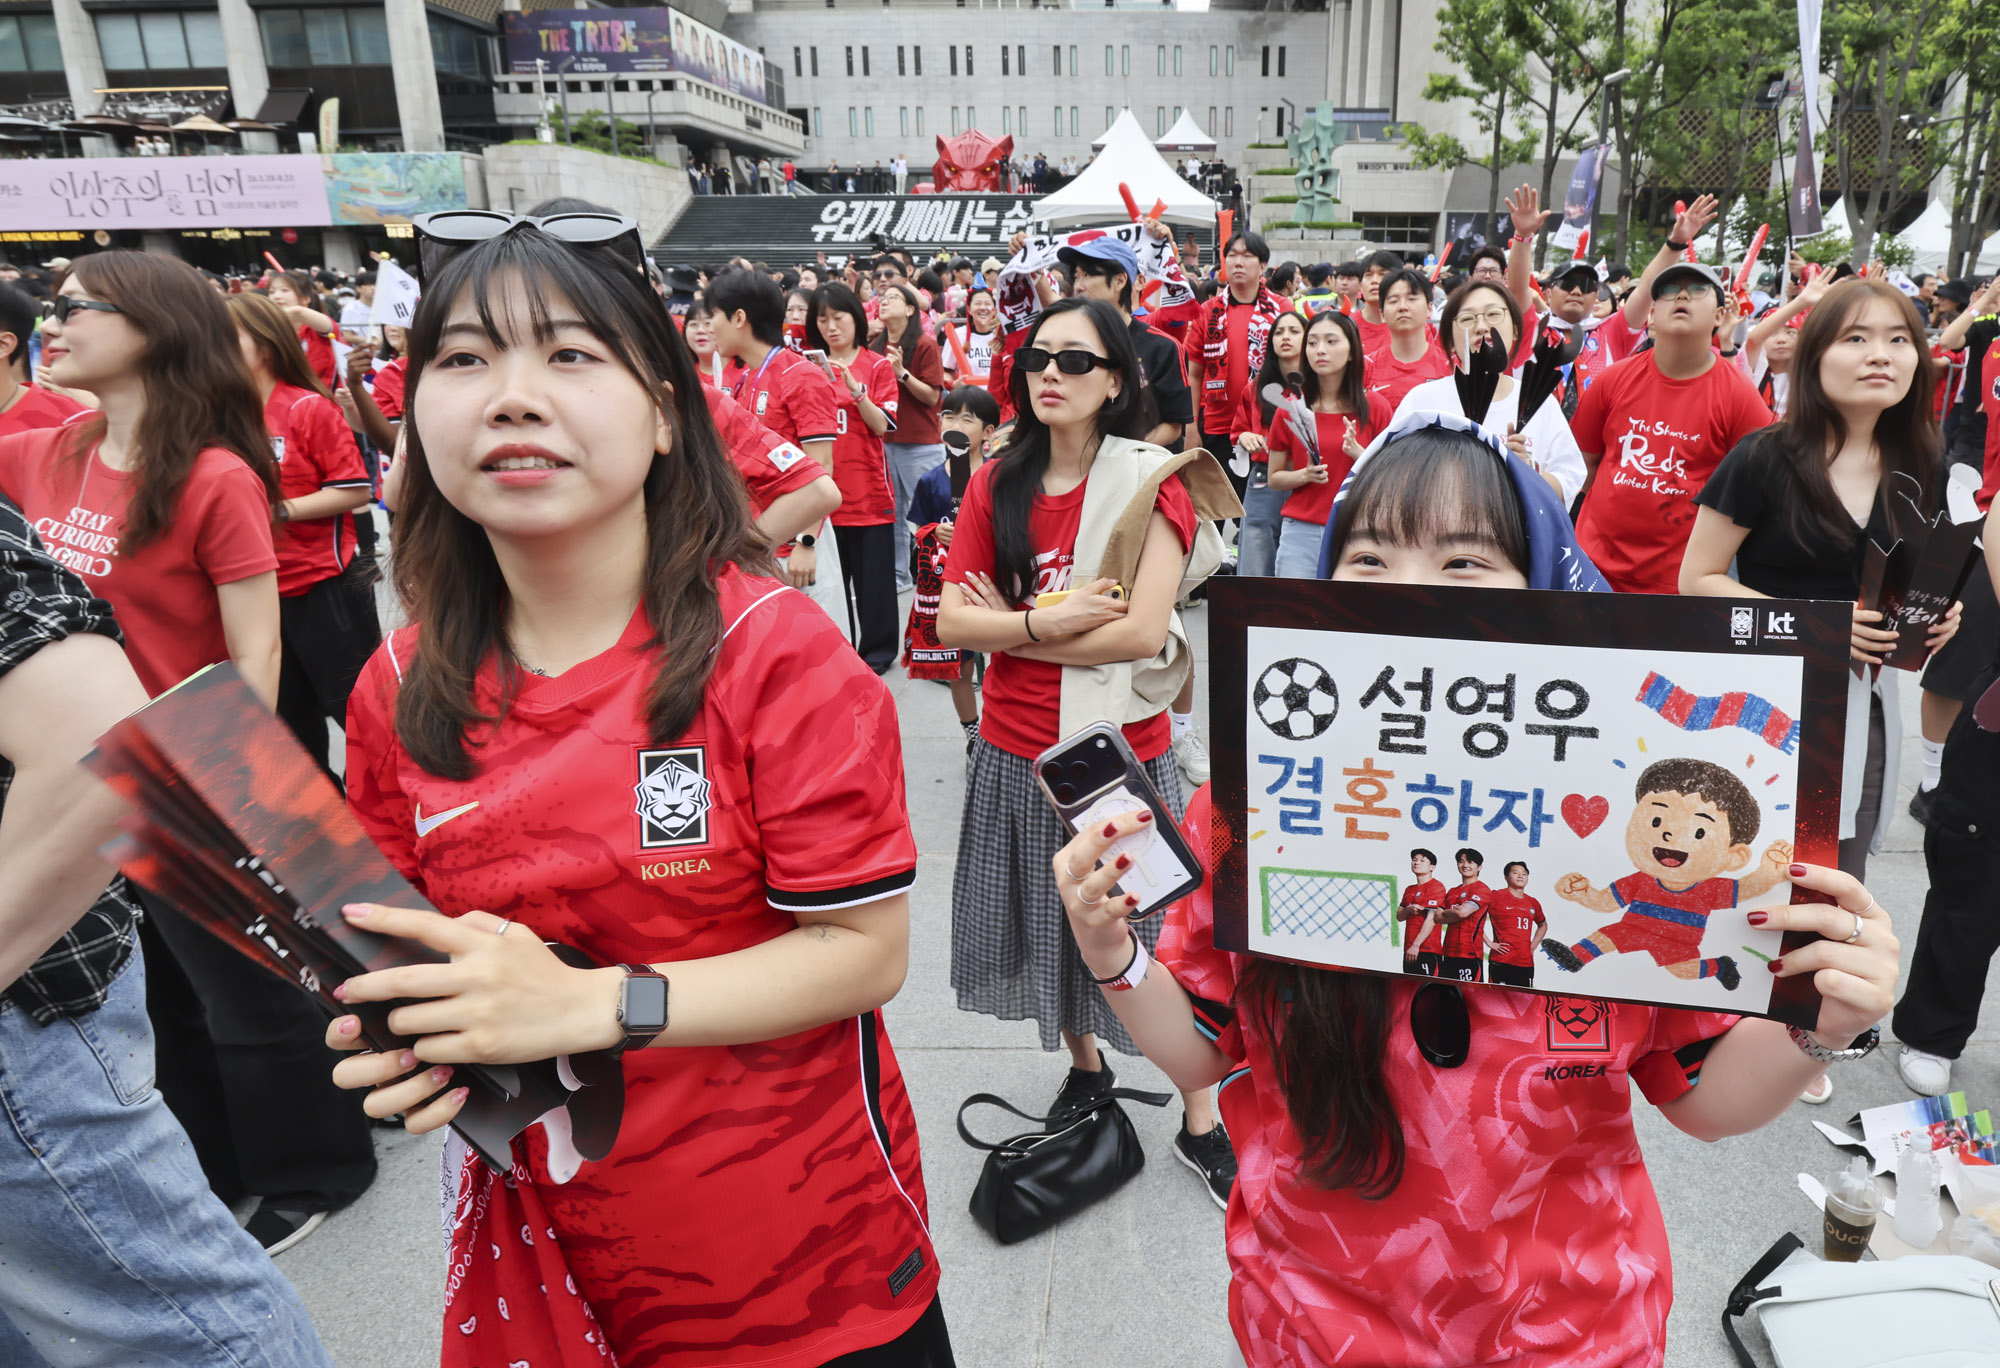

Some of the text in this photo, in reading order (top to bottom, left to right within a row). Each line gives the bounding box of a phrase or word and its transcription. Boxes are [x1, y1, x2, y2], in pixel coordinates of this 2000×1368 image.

[538, 20, 639, 53] THE TRIBE
[185, 168, 245, 216] 넘어
[811, 200, 896, 242] 우리가
[891, 200, 998, 242] 깨어나는
[968, 347, 991, 359] CALV
[1629, 416, 1651, 433] The
[1613, 471, 1648, 490] United
[65, 507, 114, 532] STAY
[34, 517, 119, 556] CURIOUS.
[1768, 611, 1795, 634] kt
[1359, 664, 1600, 763] 설영우
[1257, 753, 1555, 849] 결혼하자
[641, 858, 711, 880] KOREA
[1516, 916, 1530, 931] 13
[1421, 963, 1430, 975] 4
[1458, 968, 1473, 981] 22
[1544, 1065, 1608, 1081] KOREA
[1824, 1215, 1870, 1246] OUCH
